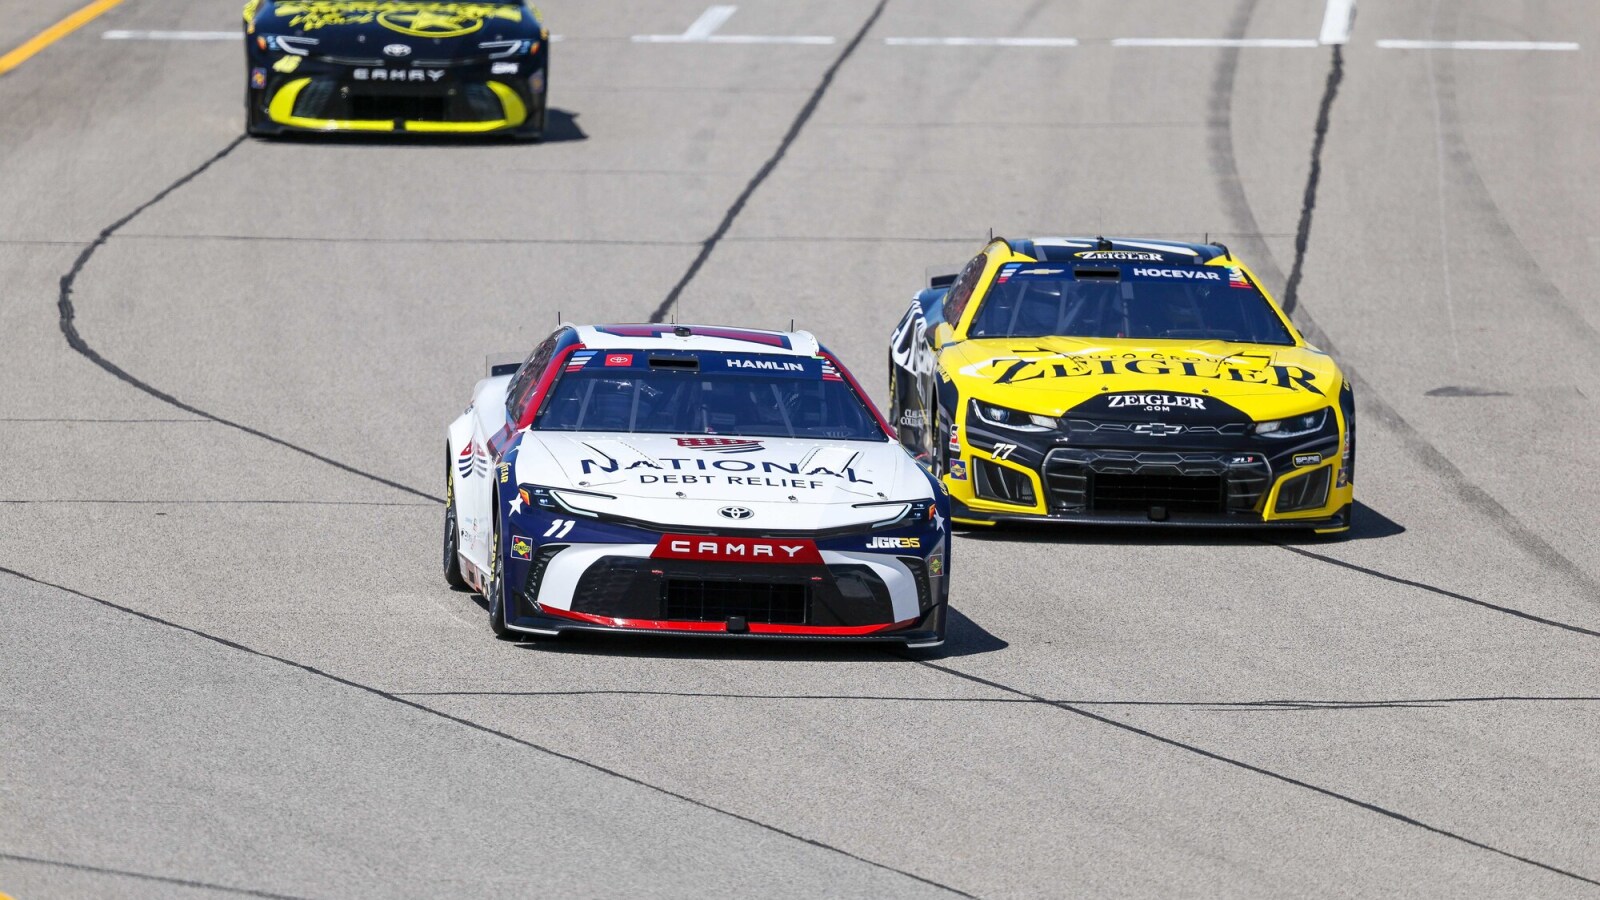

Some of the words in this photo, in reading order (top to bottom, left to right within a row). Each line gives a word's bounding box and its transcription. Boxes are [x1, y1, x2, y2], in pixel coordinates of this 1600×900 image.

[1082, 252, 1164, 262] ZEIGLER
[1133, 268, 1221, 281] HOCEVAR
[726, 359, 805, 372] HAMLIN
[992, 359, 1326, 398] ZEIGLER
[1107, 394, 1207, 410] ZEIGLER
[991, 442, 1018, 460] 77
[580, 458, 874, 484] NATIONAL
[640, 474, 716, 485] DEBT
[727, 476, 824, 490] RELIEF
[542, 518, 577, 539] 11
[671, 540, 805, 558] CAMRY
[865, 536, 921, 549] JGR35
